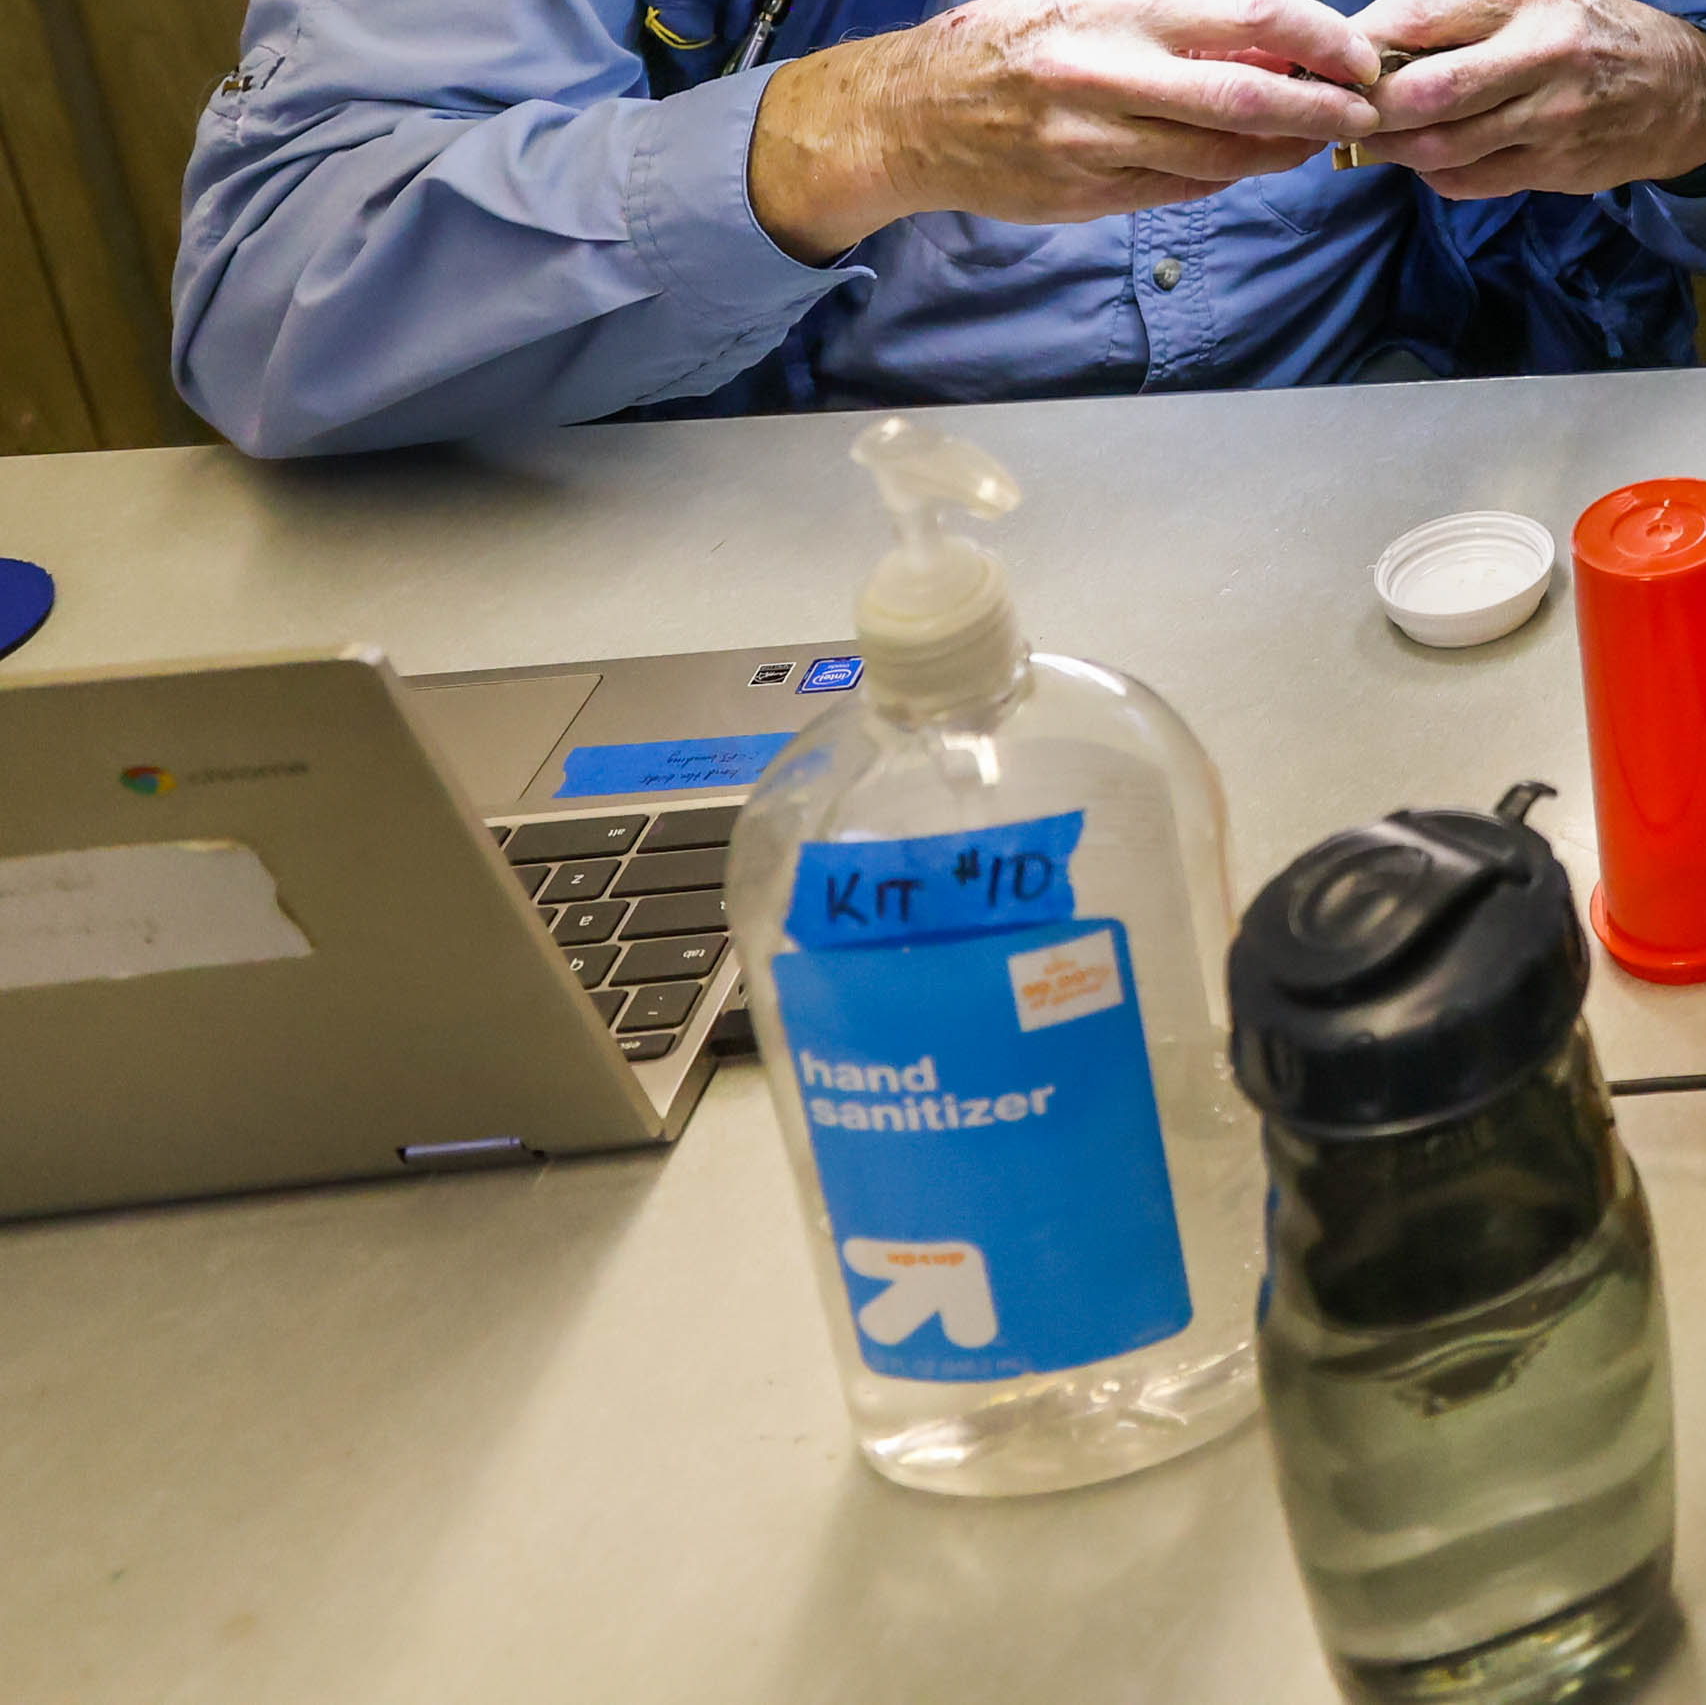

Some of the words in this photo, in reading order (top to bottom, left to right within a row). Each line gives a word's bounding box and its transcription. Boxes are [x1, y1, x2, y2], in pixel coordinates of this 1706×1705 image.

[607, 828, 626, 838] alt
[826, 872, 923, 927] KIT
[953, 848, 1053, 908] #10
[683, 948, 706, 960] tab
[801, 1051, 937, 1094] hand
[810, 1085, 1056, 1132] sanitizer
